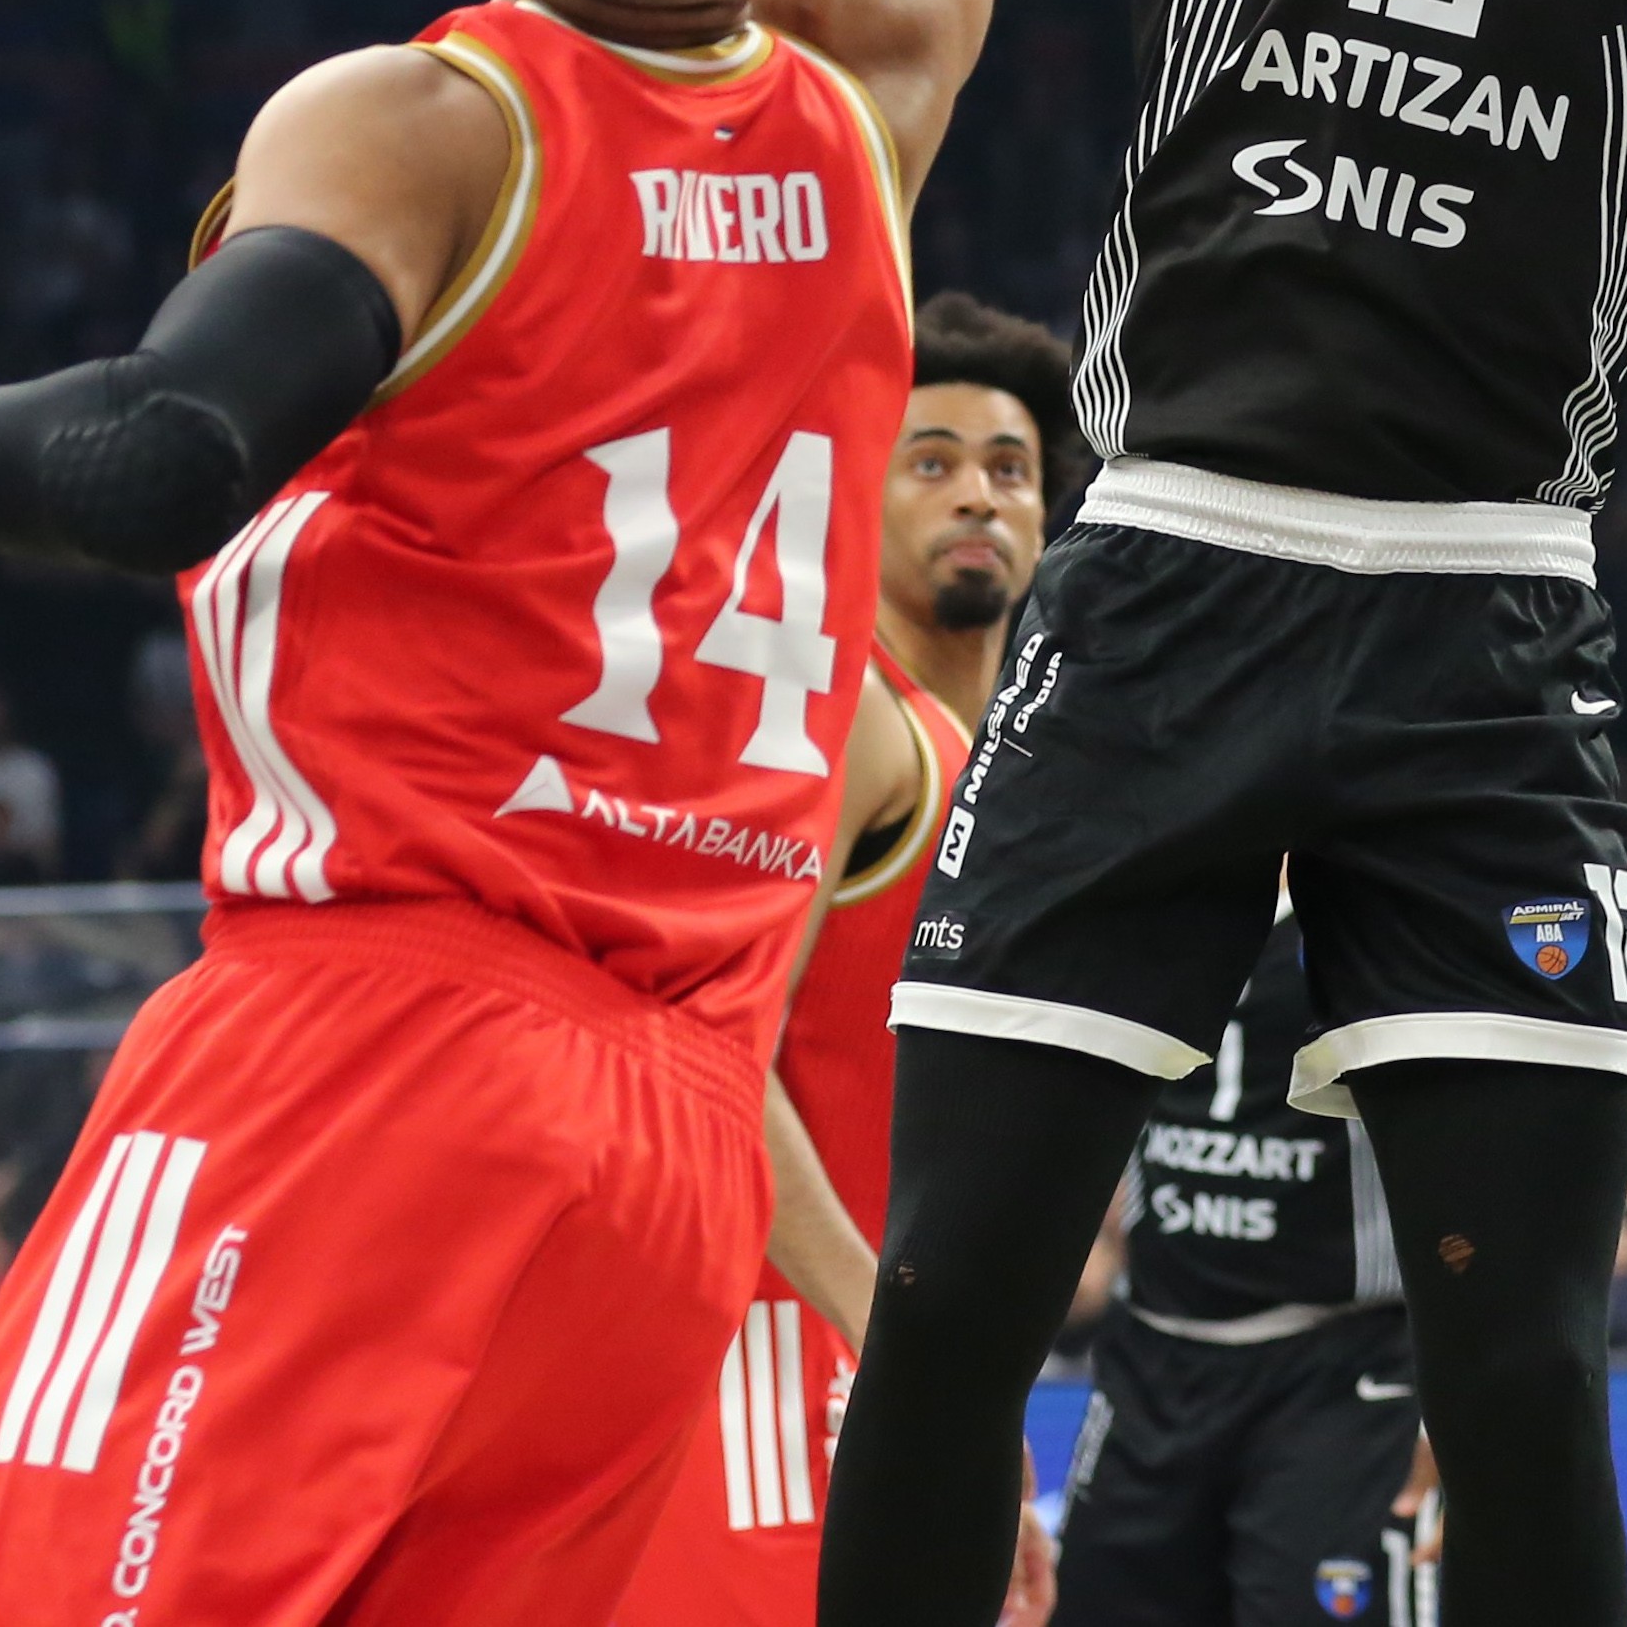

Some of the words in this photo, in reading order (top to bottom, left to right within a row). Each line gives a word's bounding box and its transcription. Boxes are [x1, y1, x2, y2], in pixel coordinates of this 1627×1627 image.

[558, 427, 836, 777] 14
[1013, 651, 1063, 734] GROUP
[580, 789, 824, 882] ALTABANKA
[914, 916, 965, 950] mts
[1512, 900, 1585, 916] ADMIRAL
[1535, 923, 1564, 943] ABA
[112, 1364, 204, 1599] CONCORD
[180, 1223, 249, 1356] WEST
